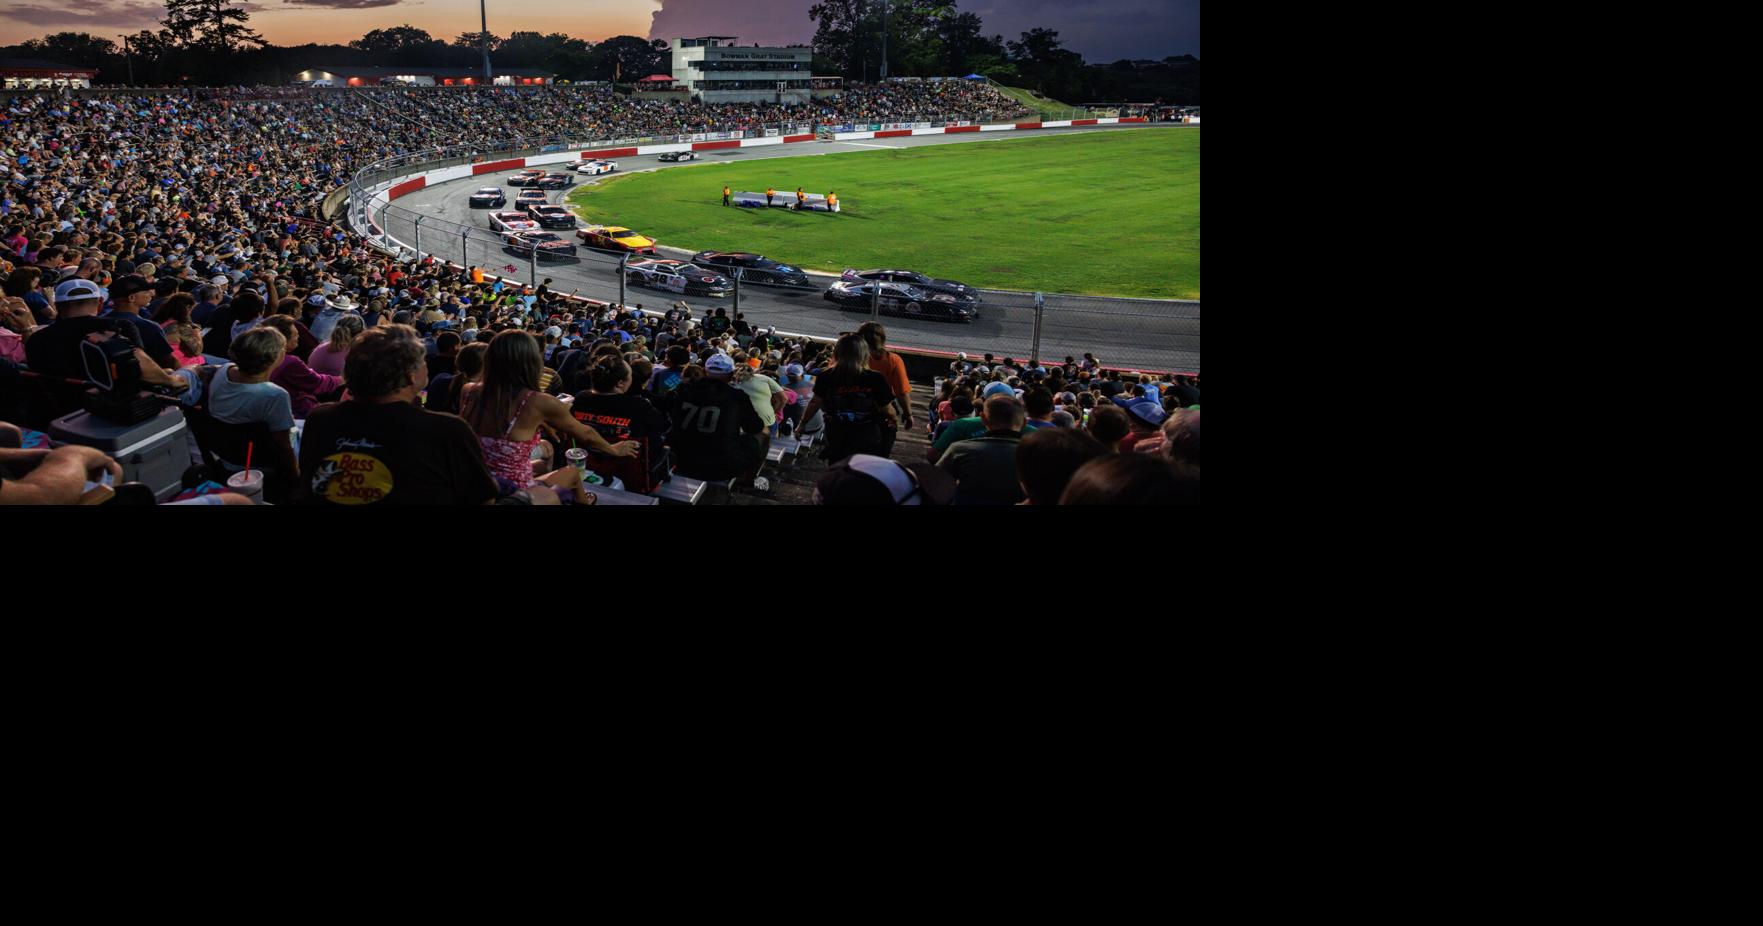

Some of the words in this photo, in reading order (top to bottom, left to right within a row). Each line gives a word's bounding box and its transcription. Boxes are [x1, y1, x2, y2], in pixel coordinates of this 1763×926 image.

[596, 415, 632, 426] SOUTH
[680, 401, 721, 433] 70
[339, 454, 375, 472] Bass
[338, 470, 365, 485] Pro
[337, 483, 382, 501] Shops
